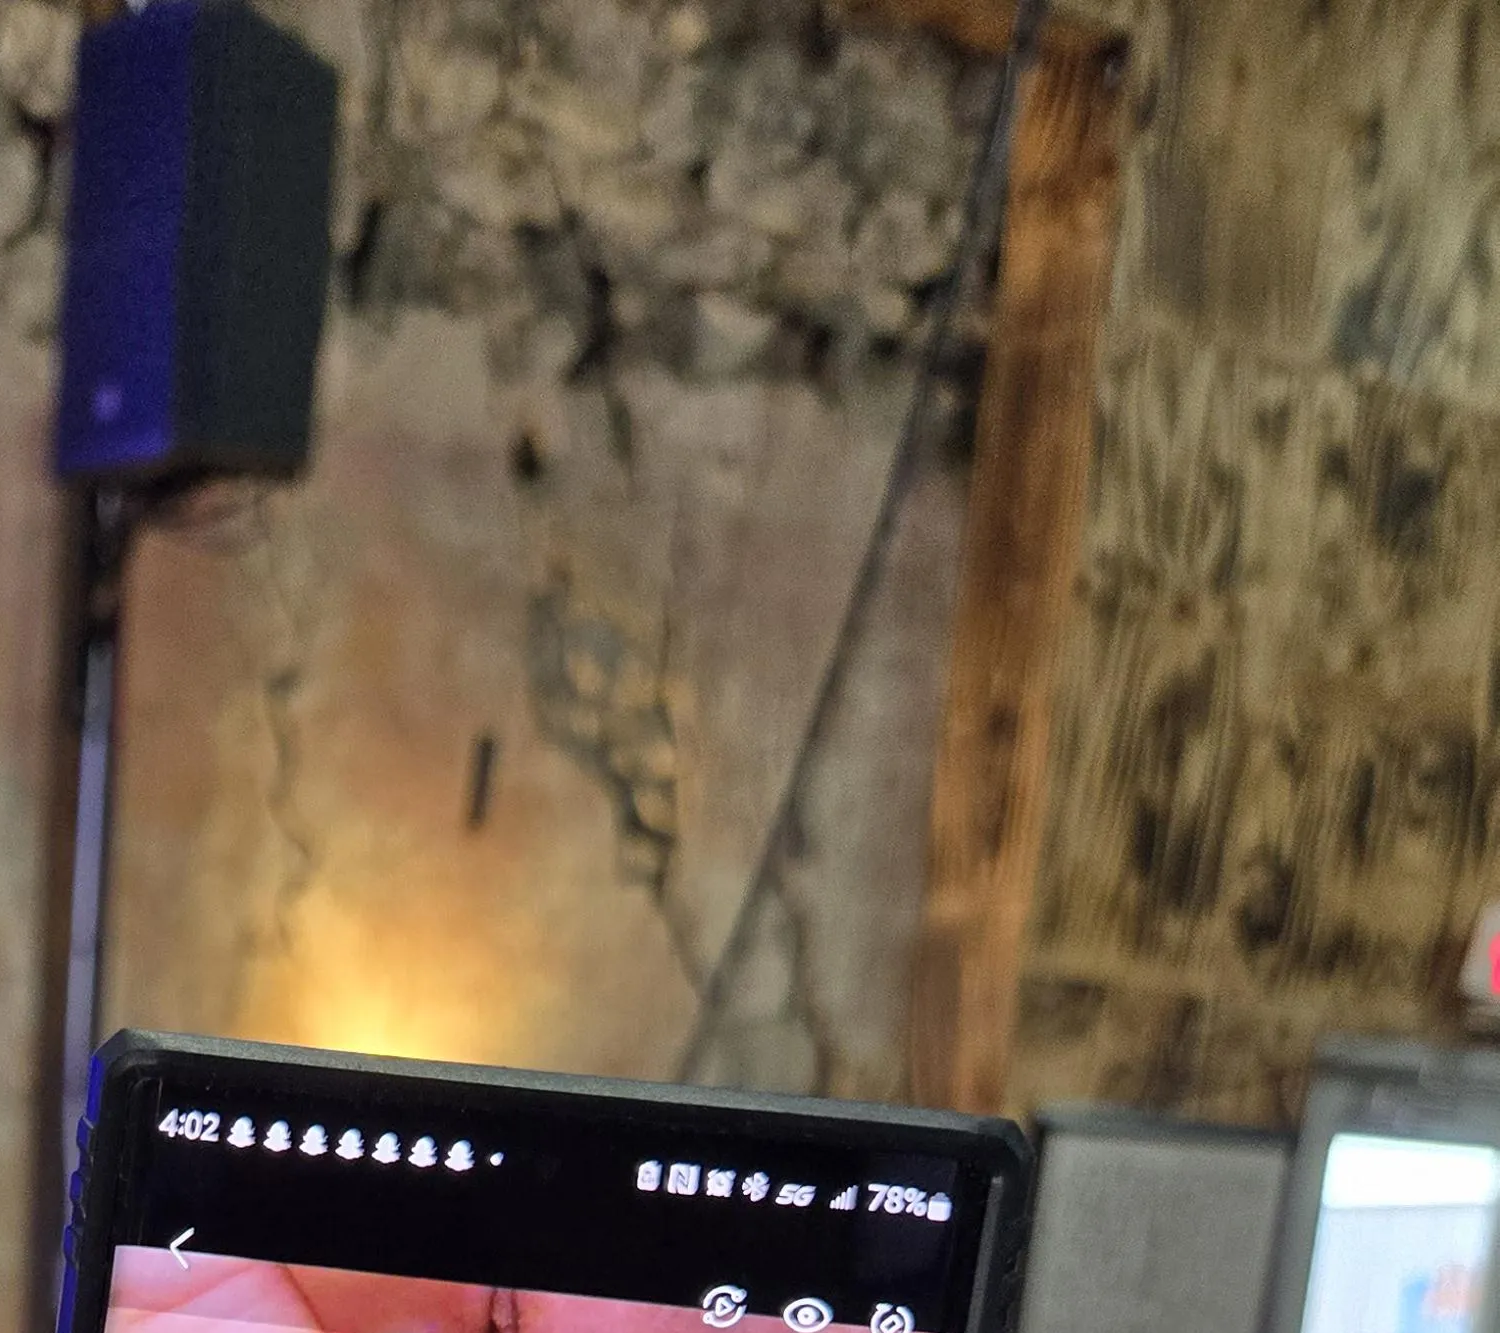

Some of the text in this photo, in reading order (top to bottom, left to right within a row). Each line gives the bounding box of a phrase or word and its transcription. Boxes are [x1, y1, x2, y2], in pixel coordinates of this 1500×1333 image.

[158, 1108, 220, 1142] 4:02
[775, 1183, 927, 1217] 5G 78%
